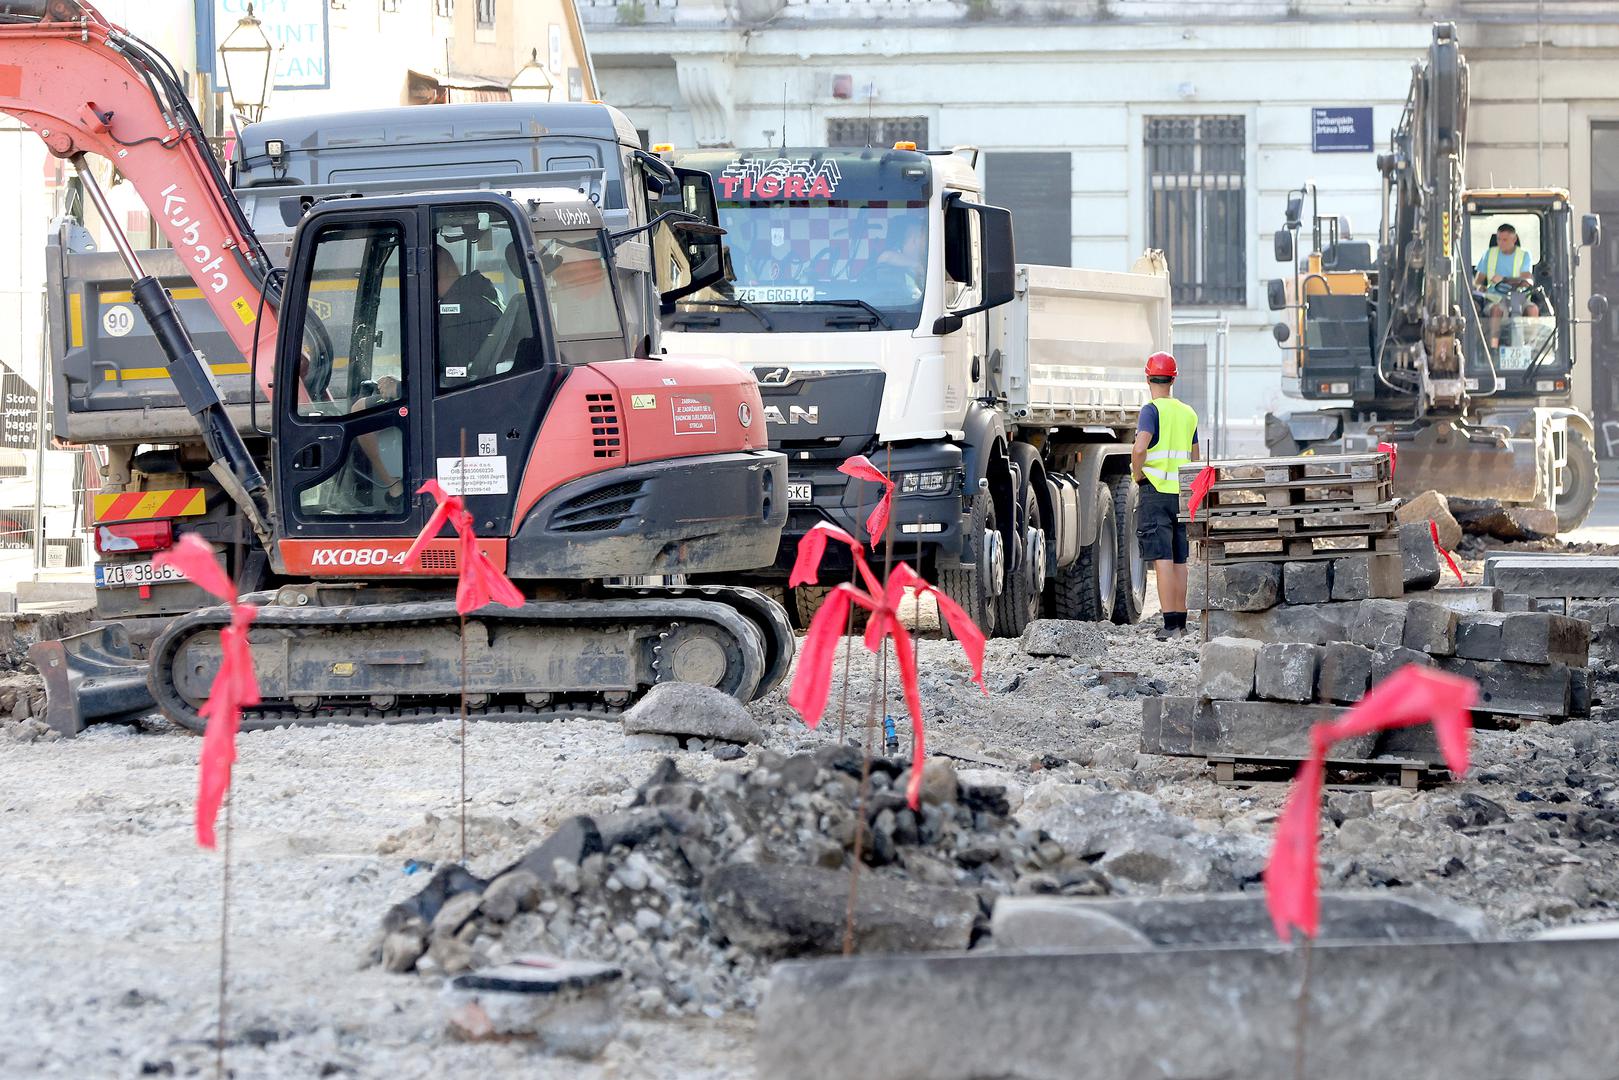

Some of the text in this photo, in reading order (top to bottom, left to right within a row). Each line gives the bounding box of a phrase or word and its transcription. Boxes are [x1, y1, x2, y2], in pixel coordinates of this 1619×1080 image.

[718, 175, 833, 199] TIGRA
[553, 207, 591, 226] Kubota
[160, 183, 229, 294] Kubota
[738, 289, 756, 302] ZG
[108, 312, 129, 329] 90
[6, 393, 37, 404] Store
[5, 407, 32, 418] your
[763, 405, 819, 425] AN
[5, 419, 53, 432] baggae
[5, 432, 30, 443] here
[480, 443, 491, 454] 96
[311, 548, 408, 566] KX080-4
[105, 566, 125, 584] ZG
